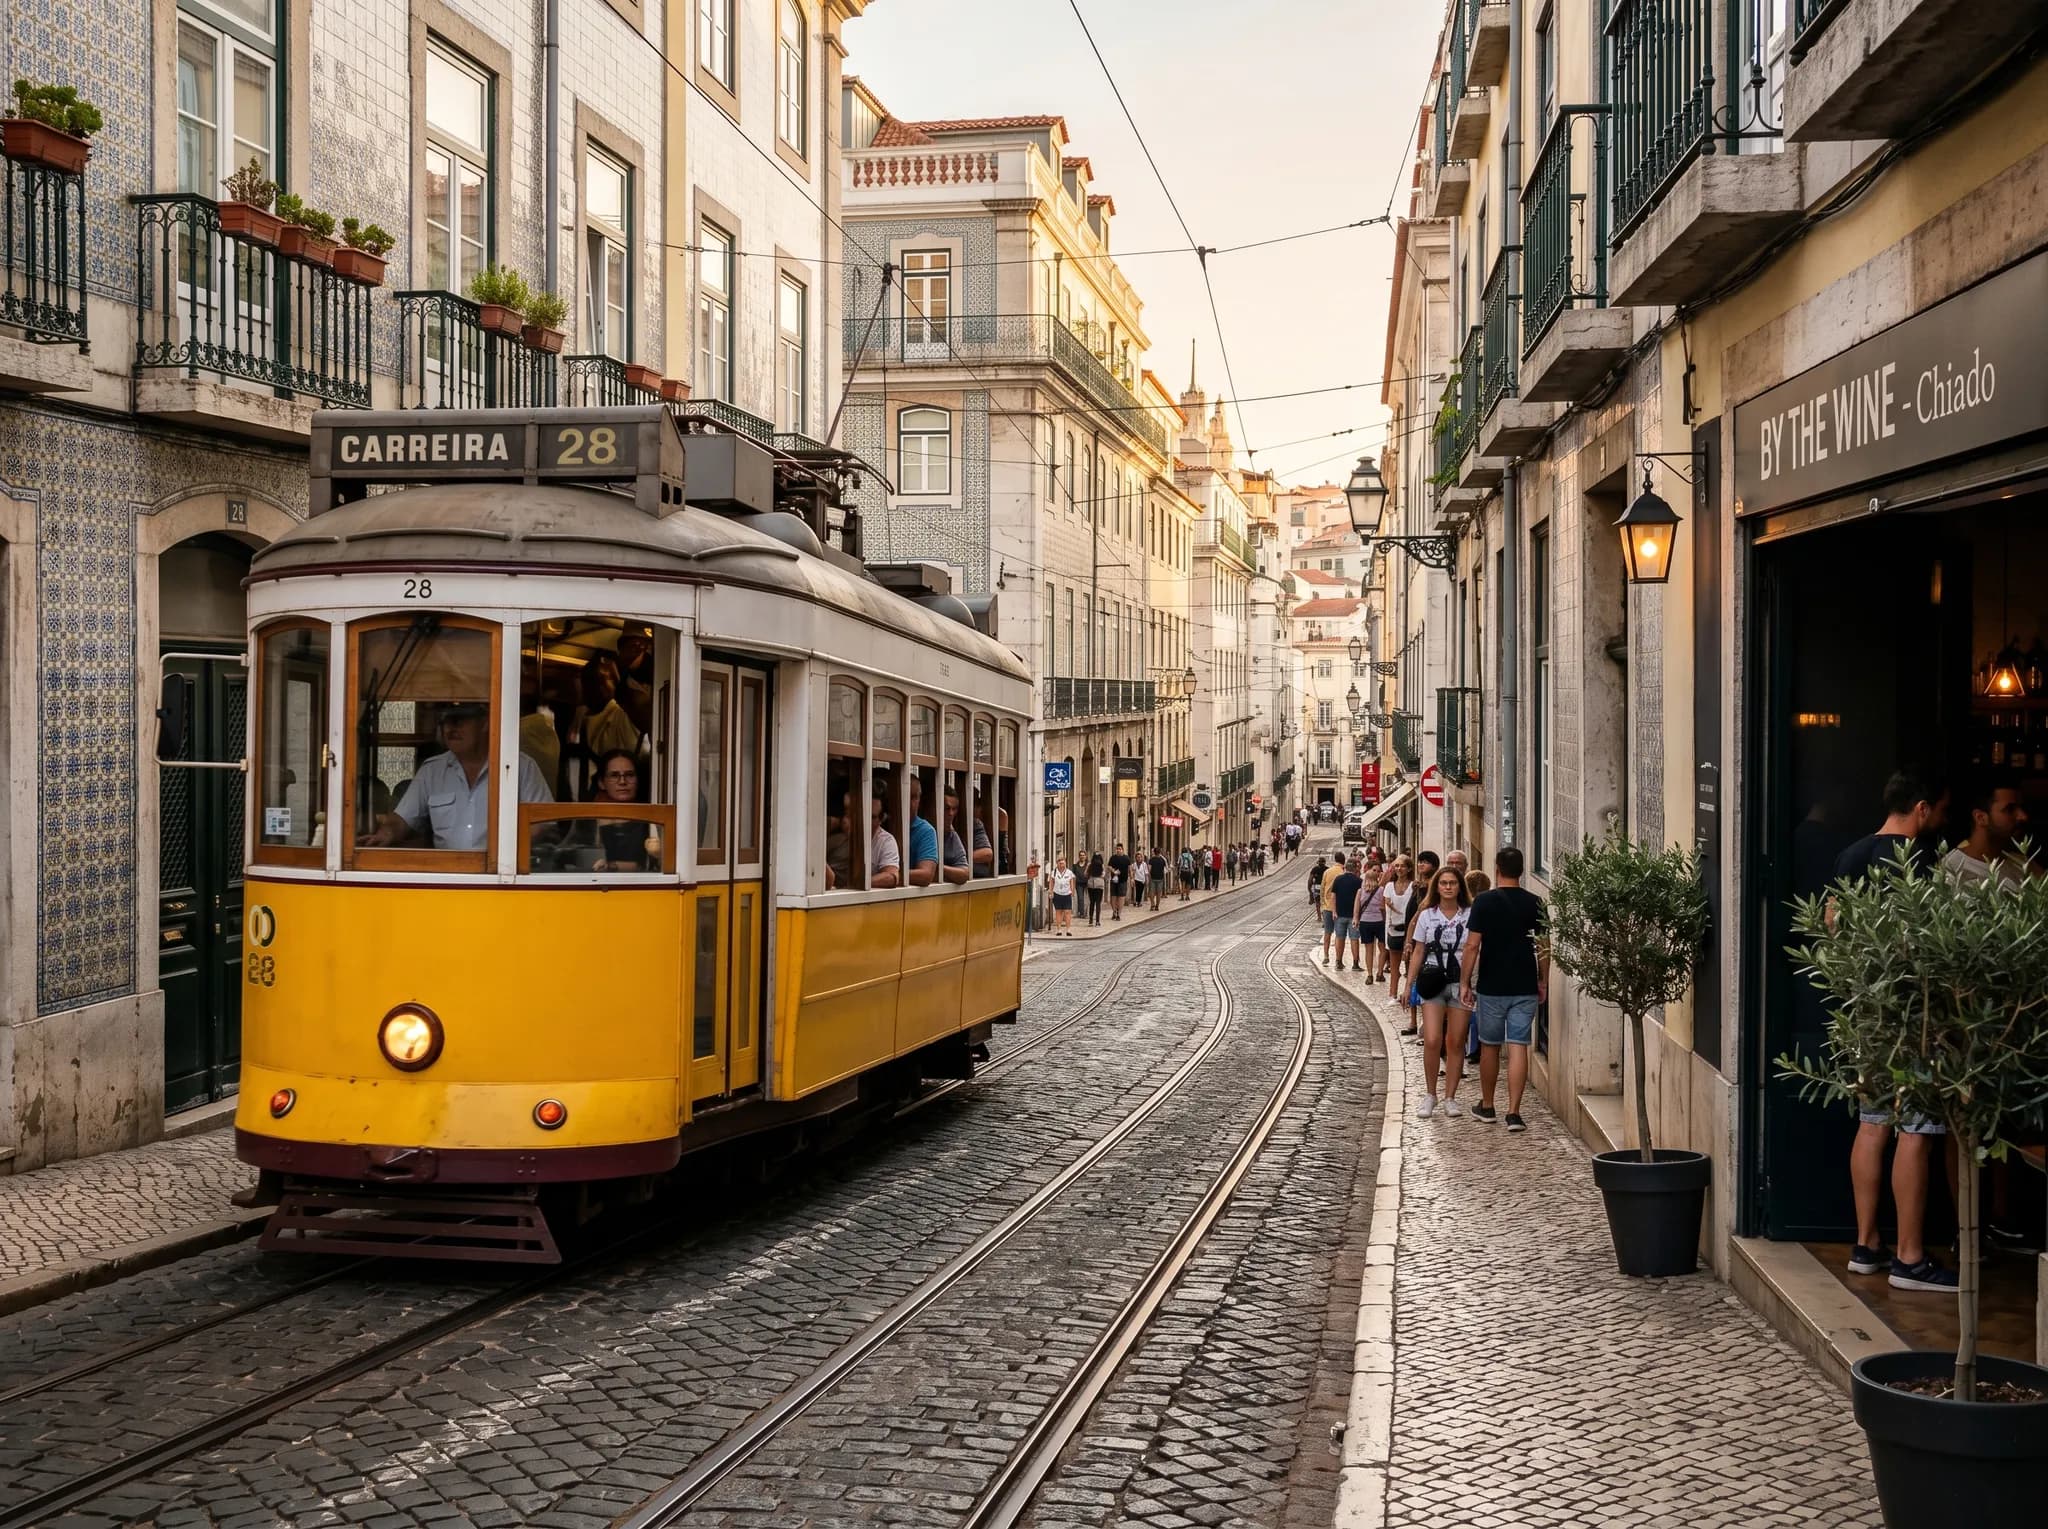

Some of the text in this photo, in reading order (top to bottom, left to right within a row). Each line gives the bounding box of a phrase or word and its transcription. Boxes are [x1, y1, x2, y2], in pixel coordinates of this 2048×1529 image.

[1761, 413, 1784, 480] BY
[1788, 393, 1828, 470] THE
[1833, 362, 1896, 454] WINE
[1916, 347, 1996, 424] Chiado
[341, 427, 617, 465] CARREIRA 28
[232, 504, 244, 521] 28
[404, 579, 432, 599] 28
